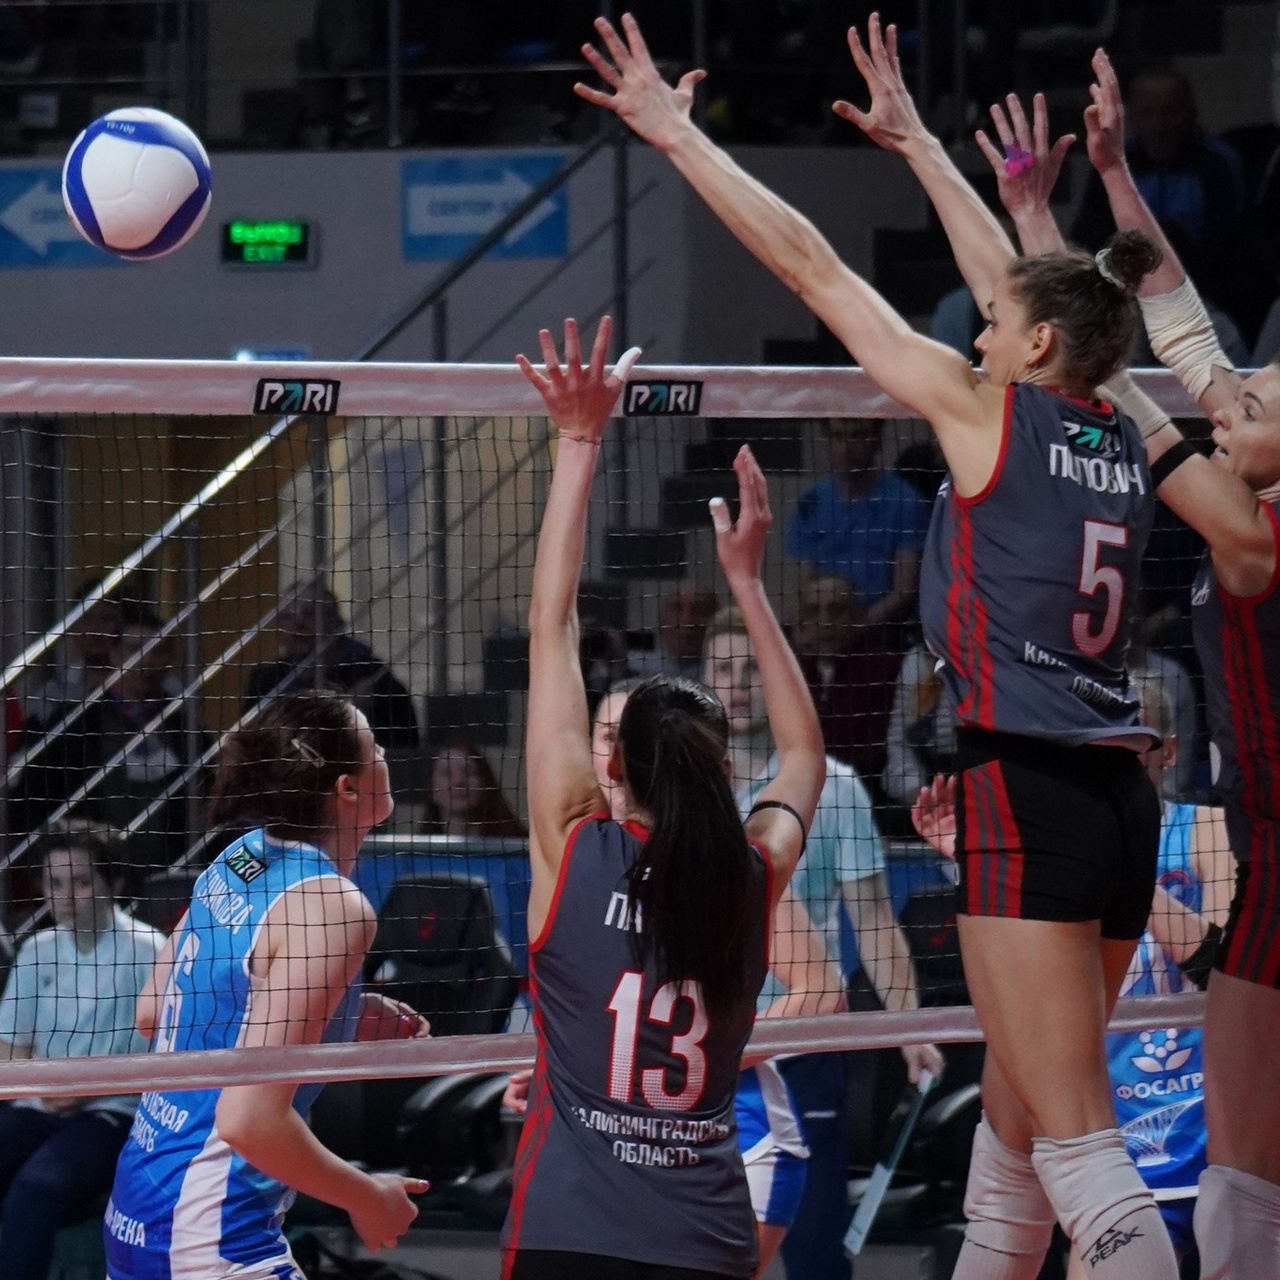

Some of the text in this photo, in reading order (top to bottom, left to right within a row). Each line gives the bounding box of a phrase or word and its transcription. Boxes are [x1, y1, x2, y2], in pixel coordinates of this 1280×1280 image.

[262, 381, 335, 412] PARI
[628, 383, 699, 413] PARI
[1071, 519, 1128, 656] 5
[606, 969, 710, 1112] 13
[1116, 1072, 1204, 1101] ФОСАГР
[571, 1105, 730, 1144] АЛИНИНГРАДСК
[613, 1140, 701, 1167] ОБЛАСТЬ
[1090, 1226, 1145, 1269] PEAK
